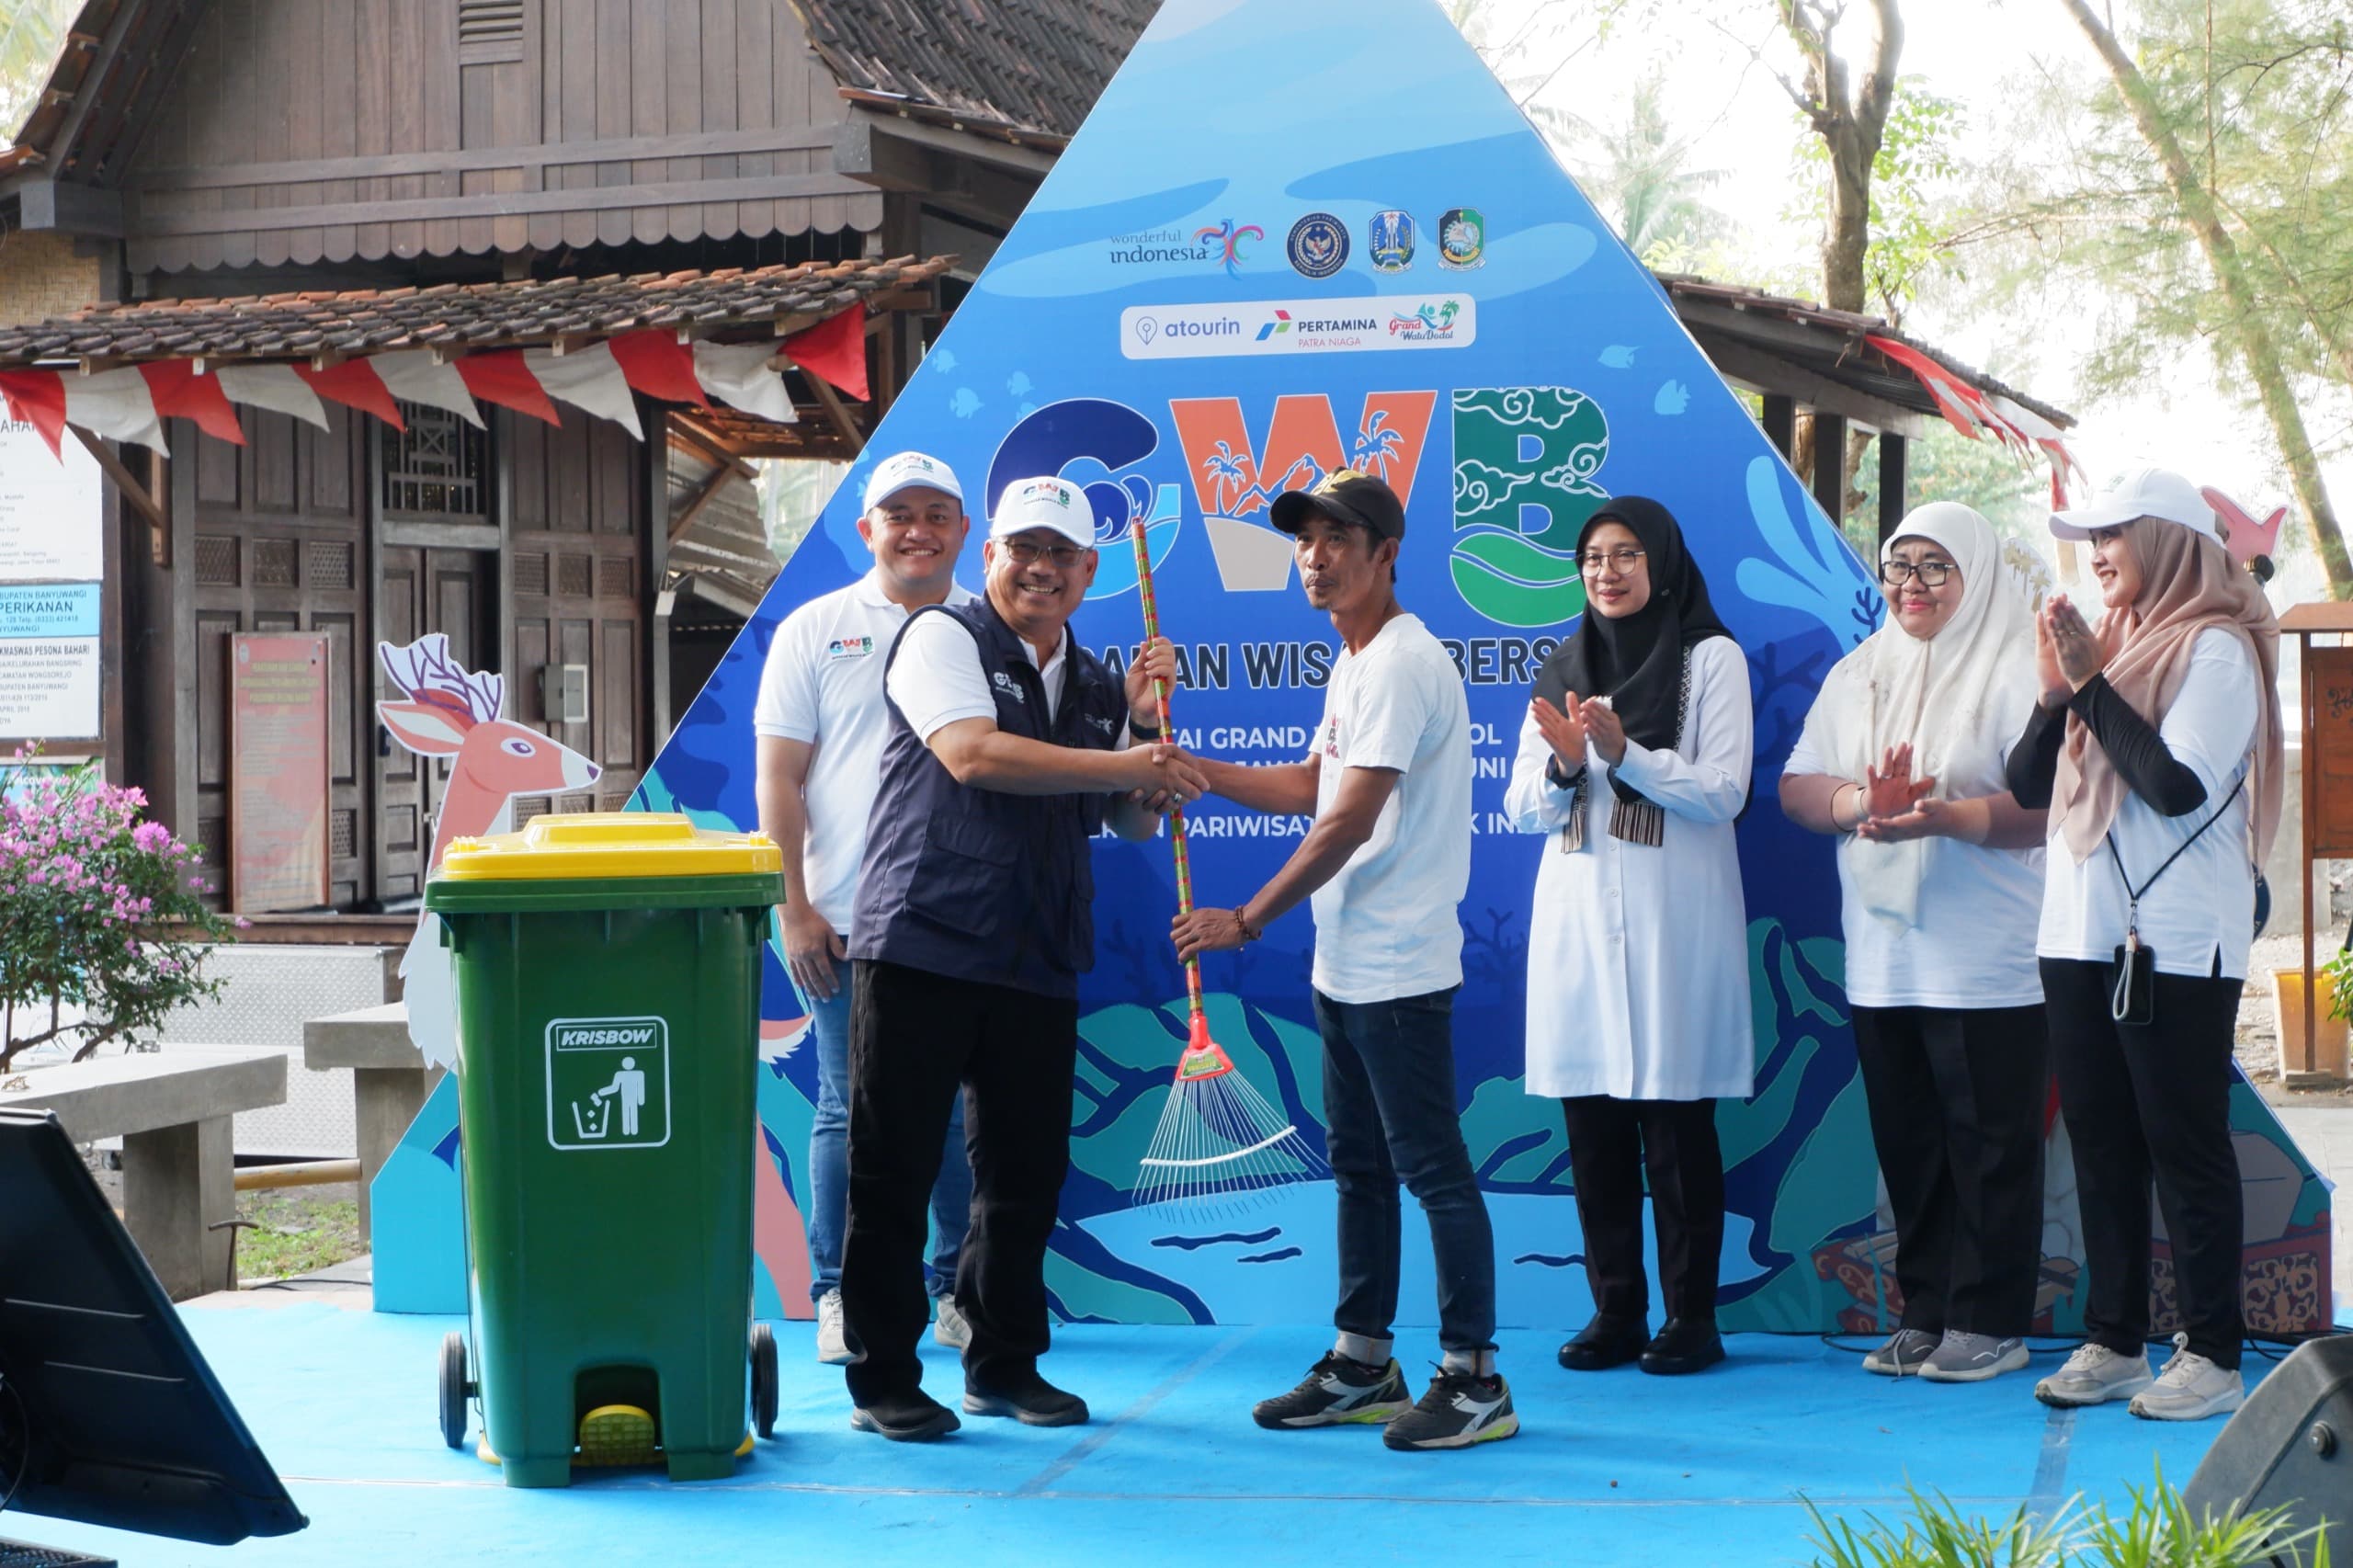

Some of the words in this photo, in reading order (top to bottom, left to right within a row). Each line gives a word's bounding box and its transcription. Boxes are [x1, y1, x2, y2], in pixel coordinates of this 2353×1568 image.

[1109, 230, 1182, 244] wonderful
[1109, 244, 1210, 264] indonesia
[1165, 316, 1241, 337] atourin
[1297, 318, 1378, 333] PERTAMINA
[1389, 317, 1422, 336] Grand
[1298, 337, 1325, 348] PATRA
[1328, 336, 1362, 347] NIAGA
[0, 419, 35, 433] AHA
[35, 589, 87, 600] BANYUWANGI
[35, 644, 63, 656] PESONA
[63, 643, 90, 655] BAHARI
[1210, 726, 1307, 750] GRAND
[561, 1028, 654, 1047] KRISBOW
